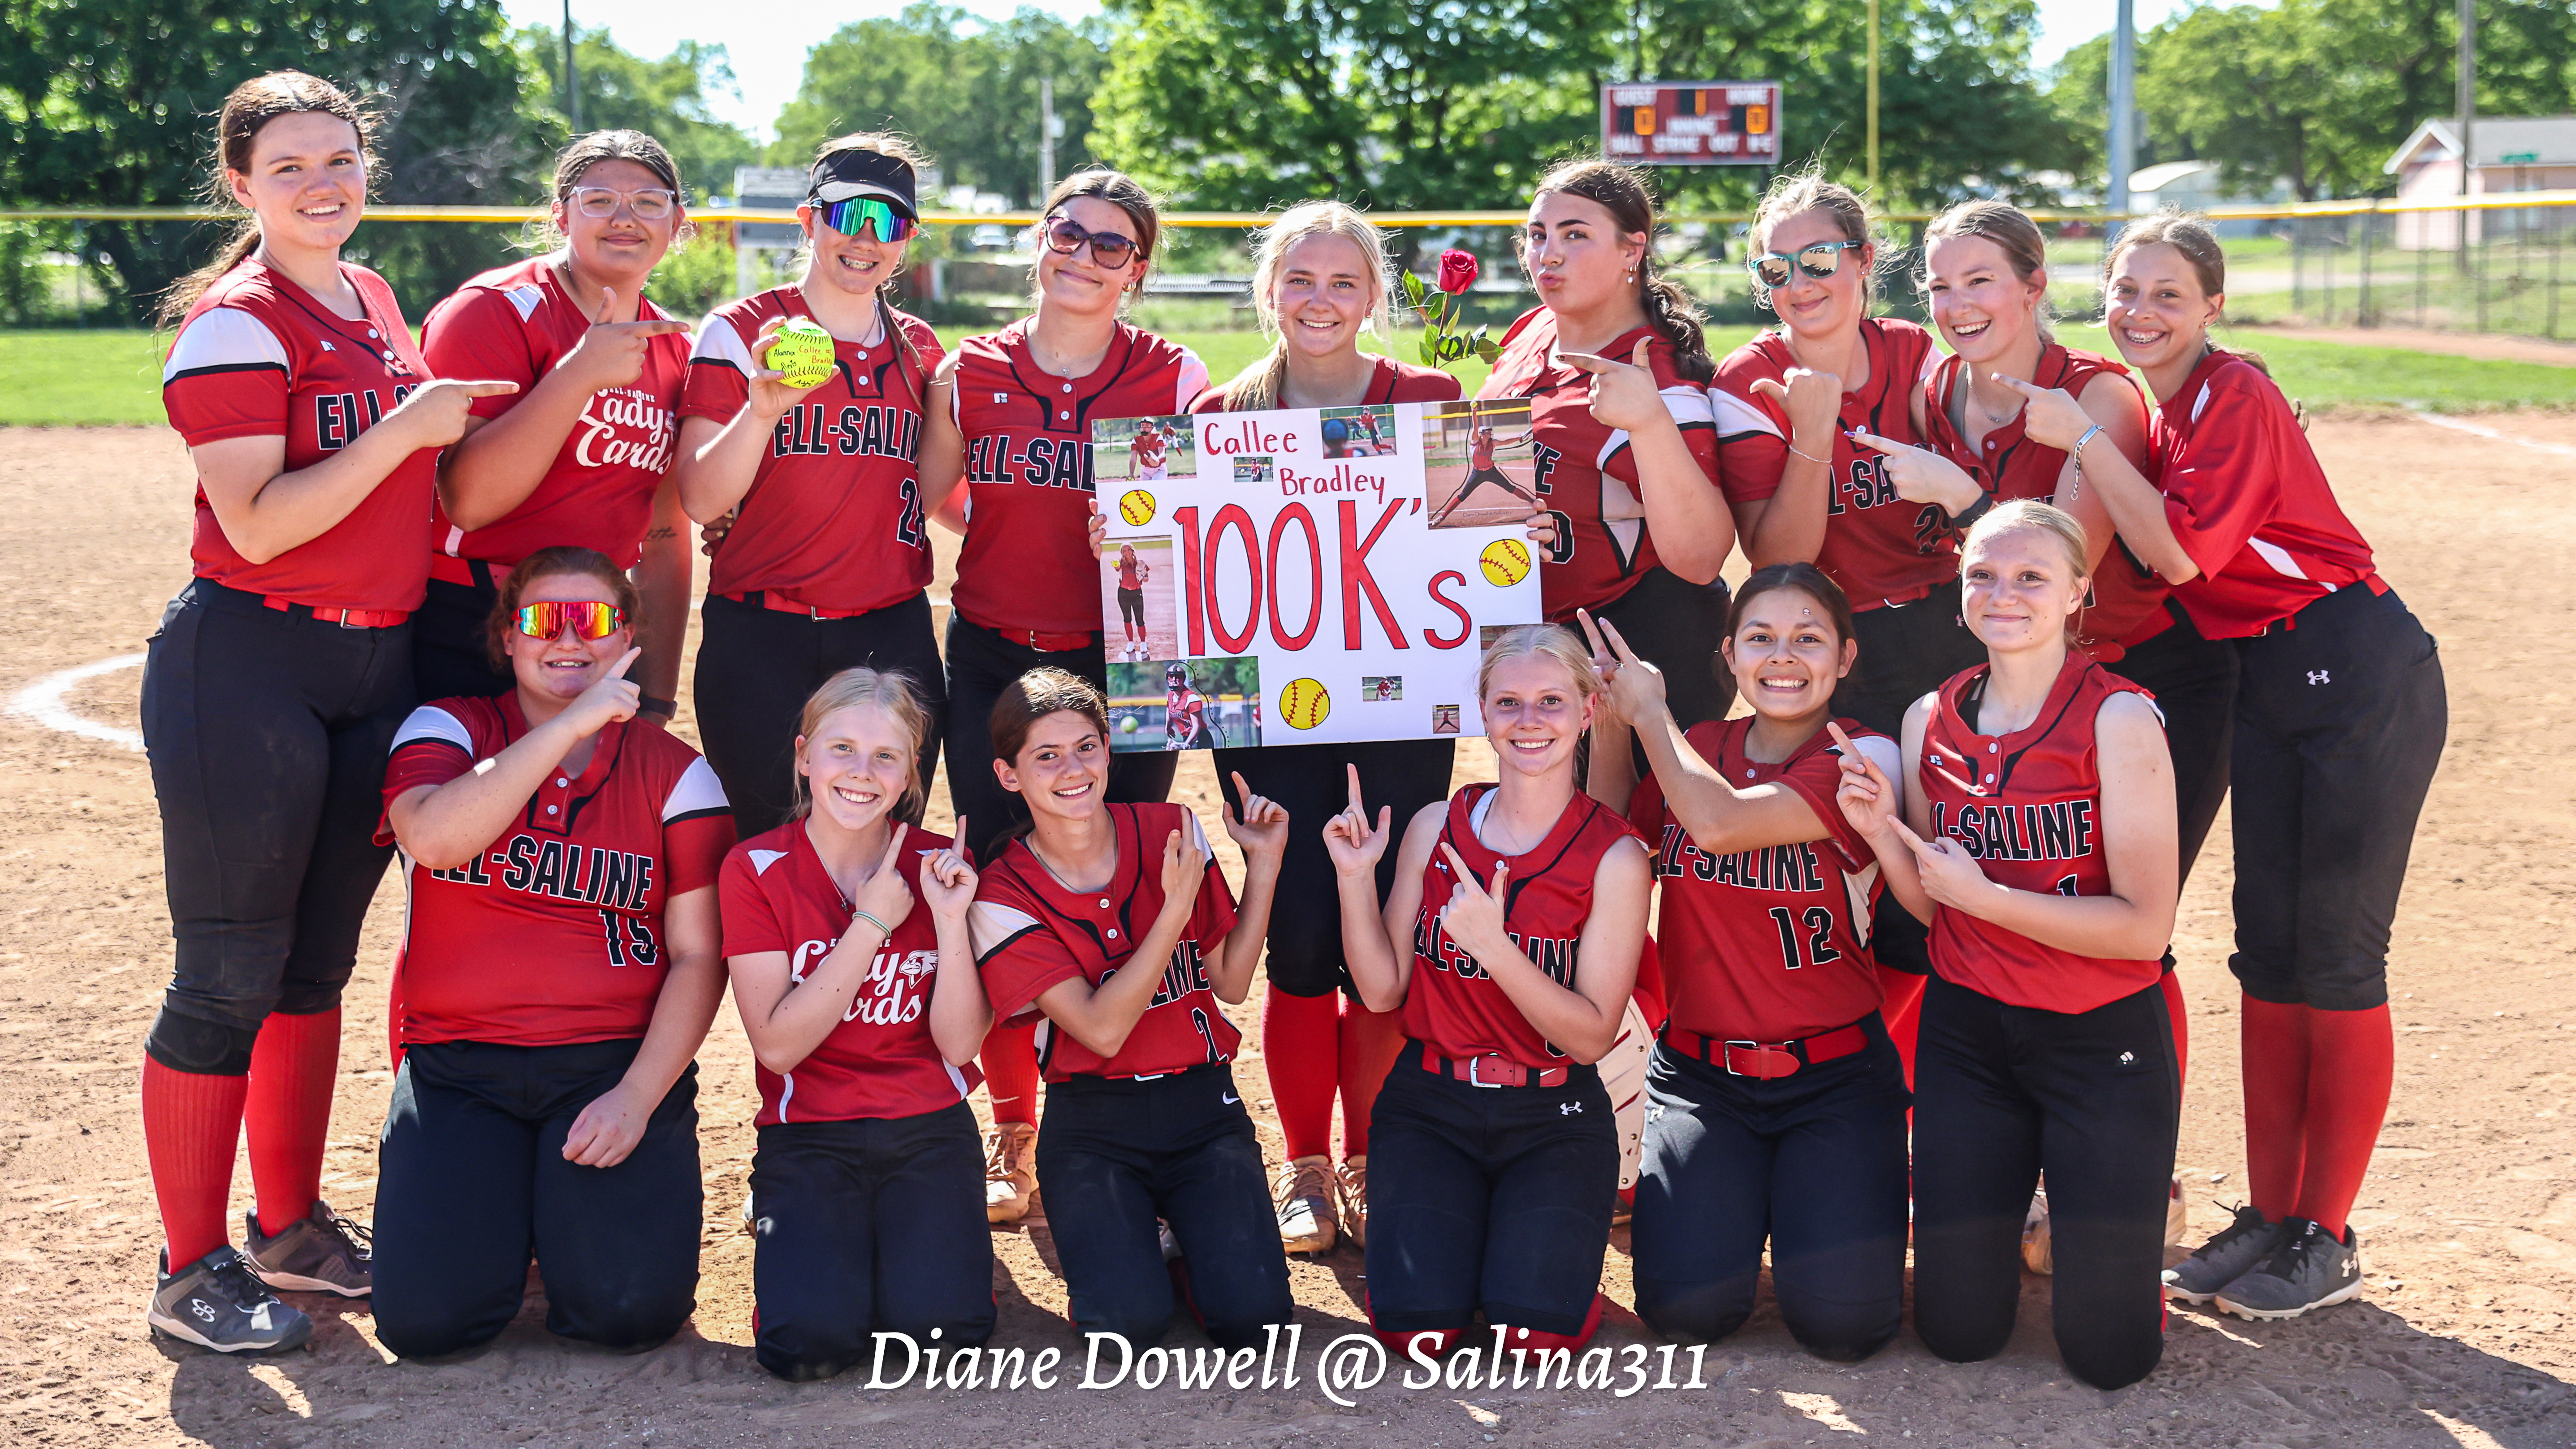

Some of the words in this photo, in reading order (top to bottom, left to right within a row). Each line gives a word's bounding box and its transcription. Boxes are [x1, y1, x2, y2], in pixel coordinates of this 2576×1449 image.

[774, 349, 795, 357] Alanna
[578, 388, 664, 445] Lady
[1205, 421, 1298, 456] Callee
[576, 424, 673, 475] Cards
[1280, 464, 1385, 505] Bradley
[1828, 454, 1902, 516] L-SA
[1930, 799, 2092, 861] L-SALINE
[431, 834, 653, 911] L-SALINE
[599, 909, 658, 967] 15
[1768, 906, 1841, 970] 12
[791, 940, 900, 997] Ly
[1145, 939, 1210, 1011] LINE
